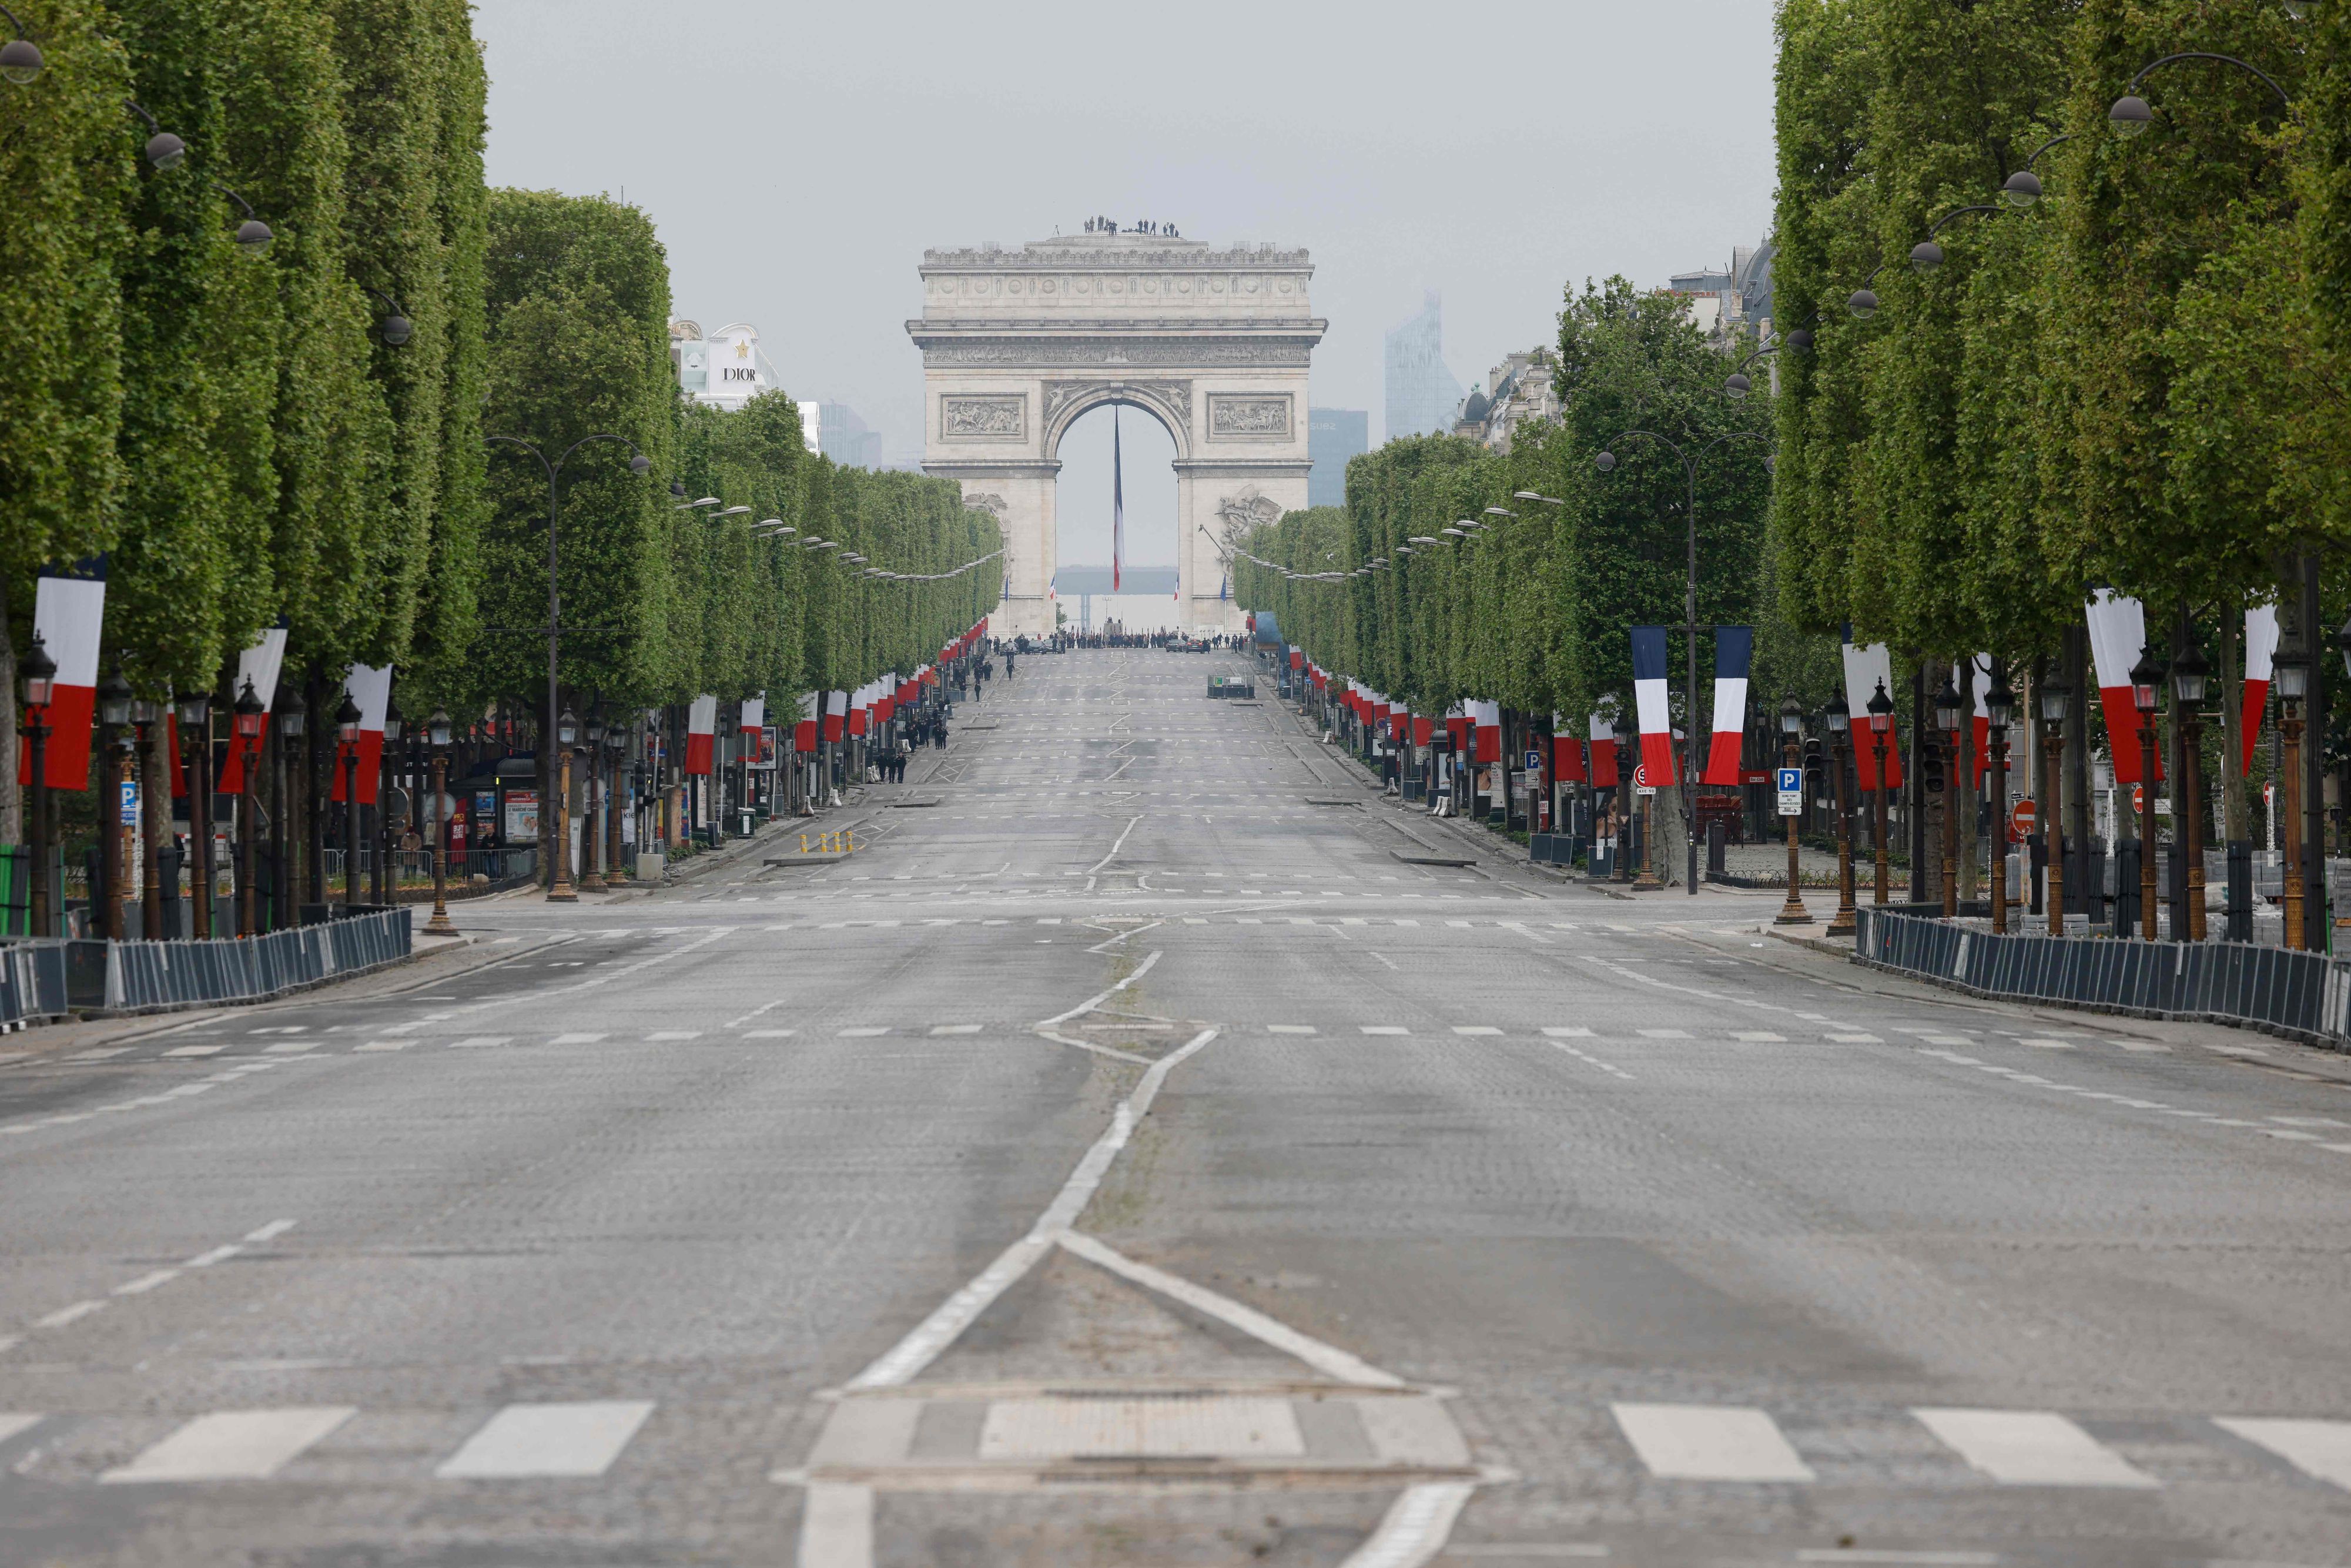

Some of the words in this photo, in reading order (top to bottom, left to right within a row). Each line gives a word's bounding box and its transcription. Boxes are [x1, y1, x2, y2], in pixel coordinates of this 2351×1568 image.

[724, 367, 755, 381] DIOR
[1531, 755, 1539, 766] P
[1640, 771, 1645, 780] 5
[1784, 773, 1795, 788] P
[122, 788, 134, 804] P
